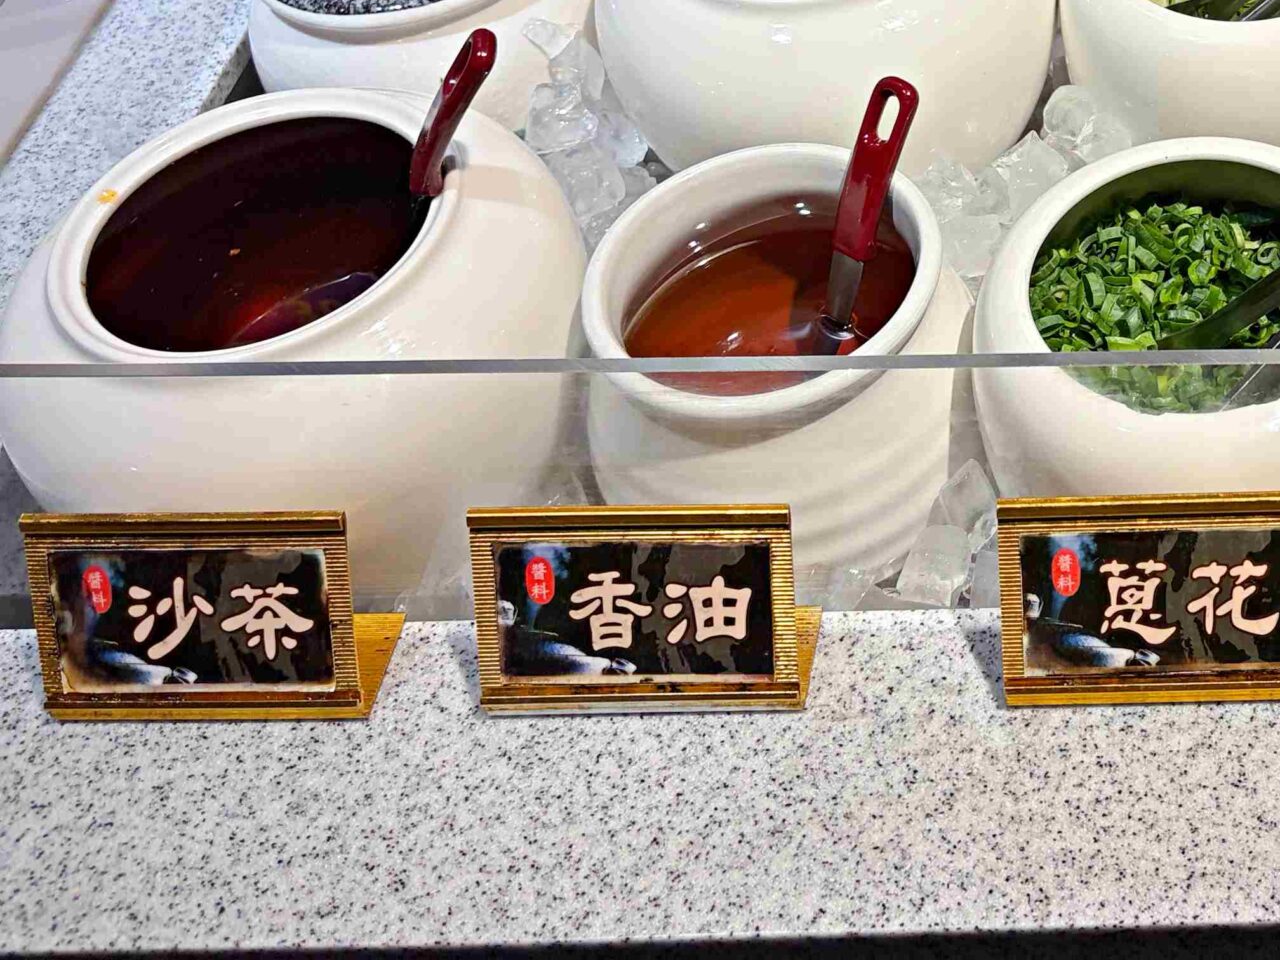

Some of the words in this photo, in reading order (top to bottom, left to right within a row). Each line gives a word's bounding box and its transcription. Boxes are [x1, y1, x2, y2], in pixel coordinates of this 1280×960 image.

[530, 562, 549, 600] 醬料
[1056, 553, 1075, 591] 醬料
[127, 576, 314, 661] 沙茶
[568, 570, 753, 652] 香油
